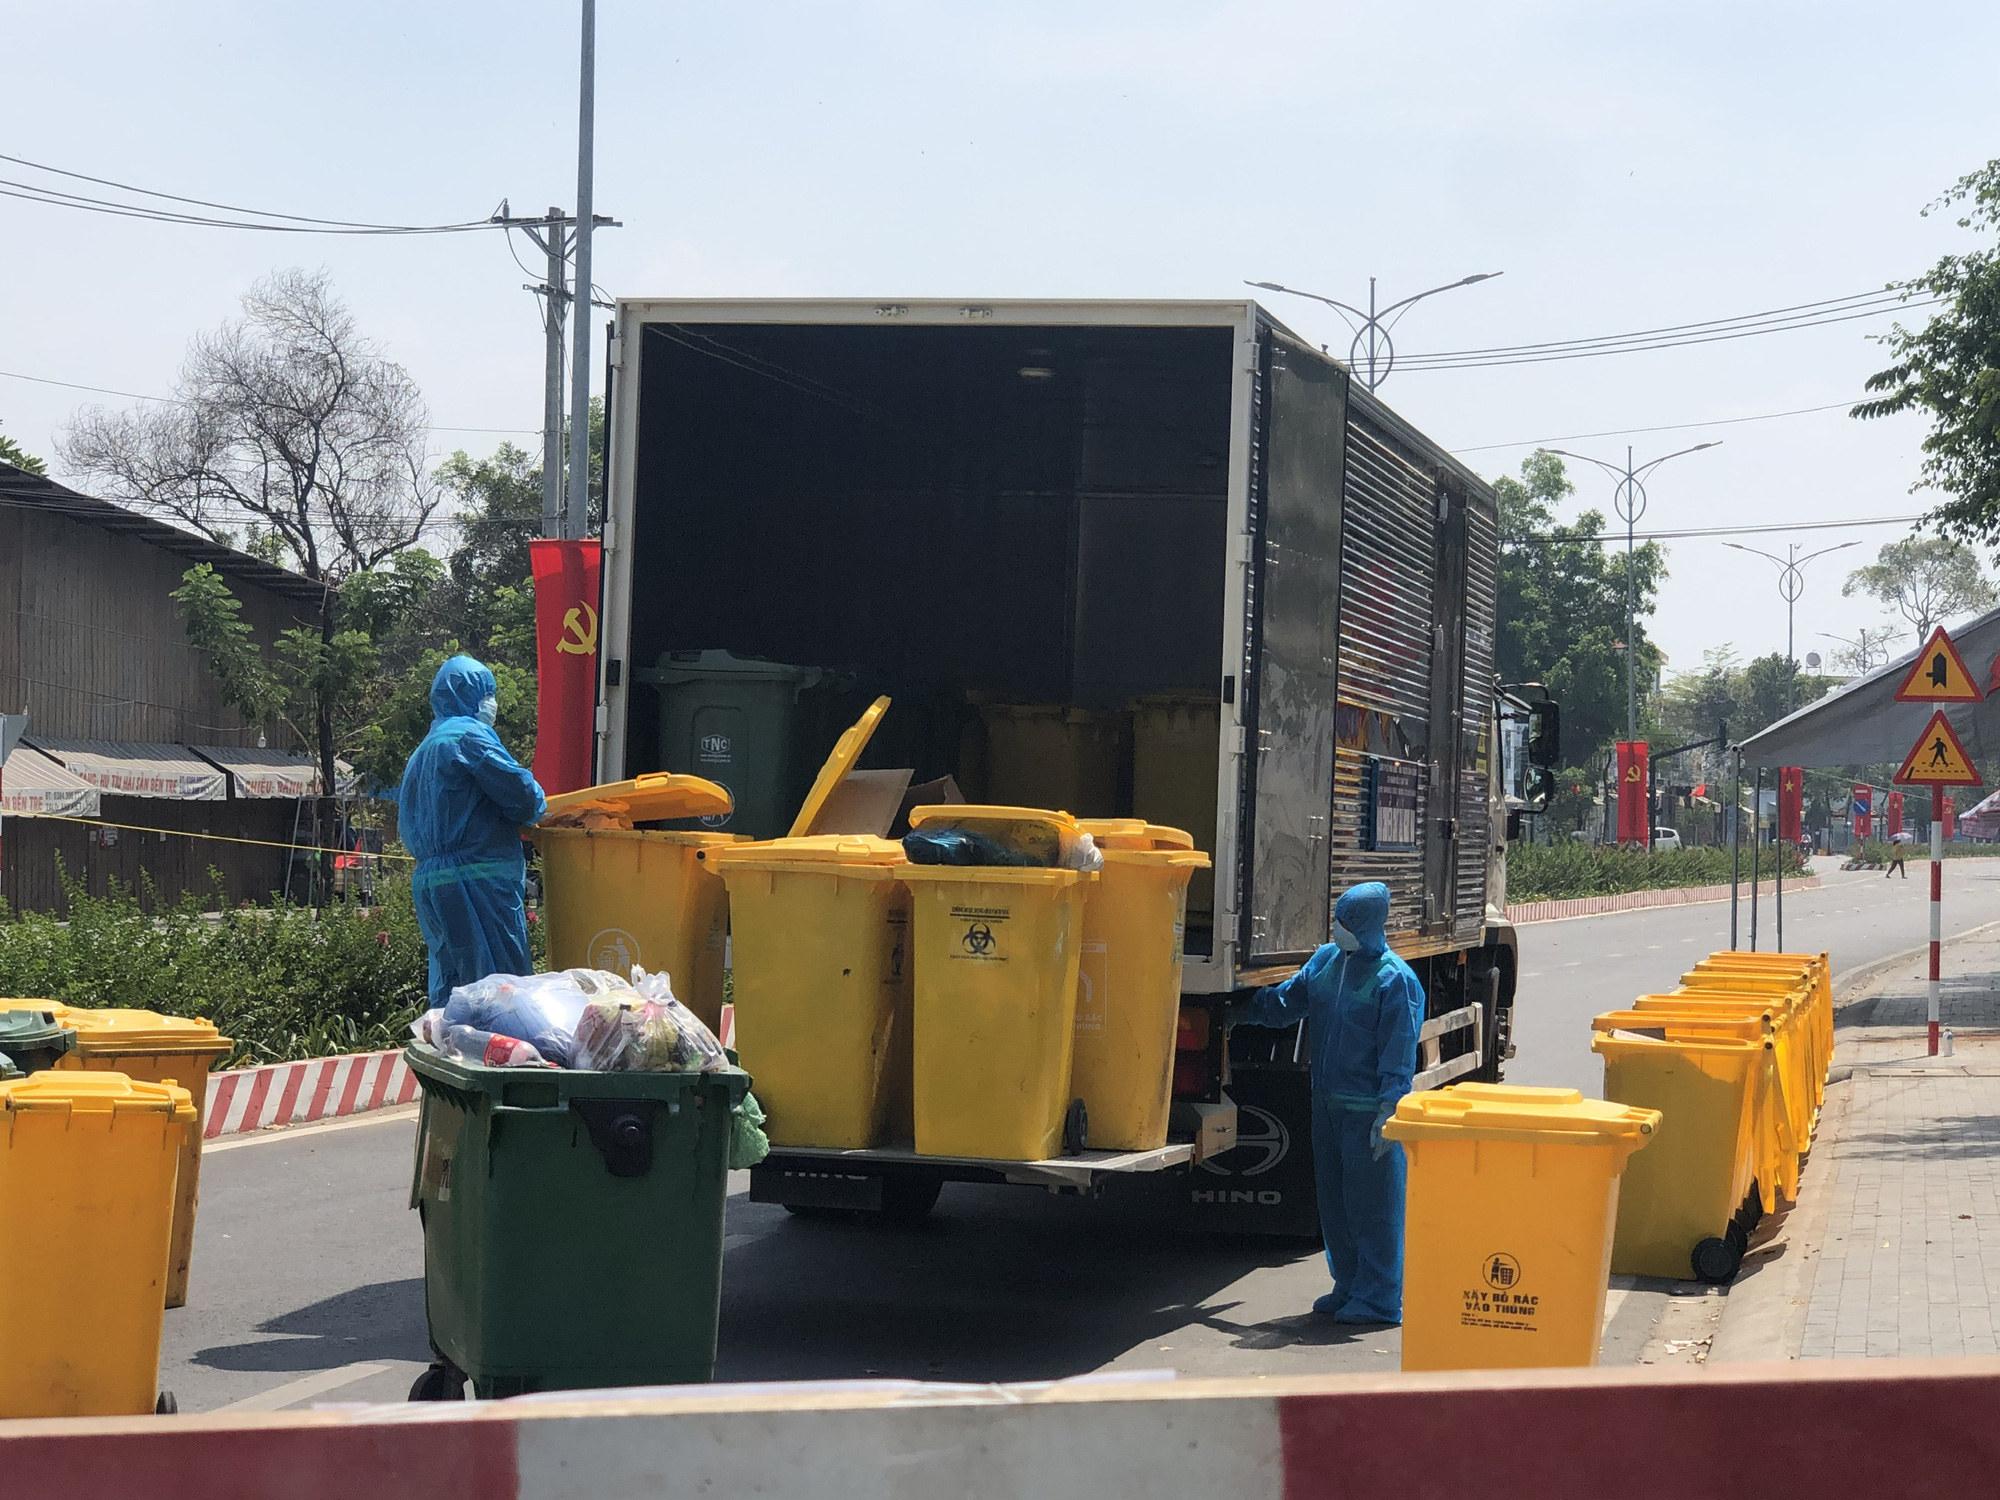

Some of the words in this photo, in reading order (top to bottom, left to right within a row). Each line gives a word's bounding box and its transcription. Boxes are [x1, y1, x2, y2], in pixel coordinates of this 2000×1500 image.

[704, 737, 728, 751] TNC
[165, 779, 178, 794] TRE
[12, 789, 27, 811] BẾN
[29, 796, 43, 811] TRE
[1191, 1190, 1281, 1205] HINO
[1492, 1291, 1509, 1303] BỎ
[1513, 1294, 1539, 1306] RÁC
